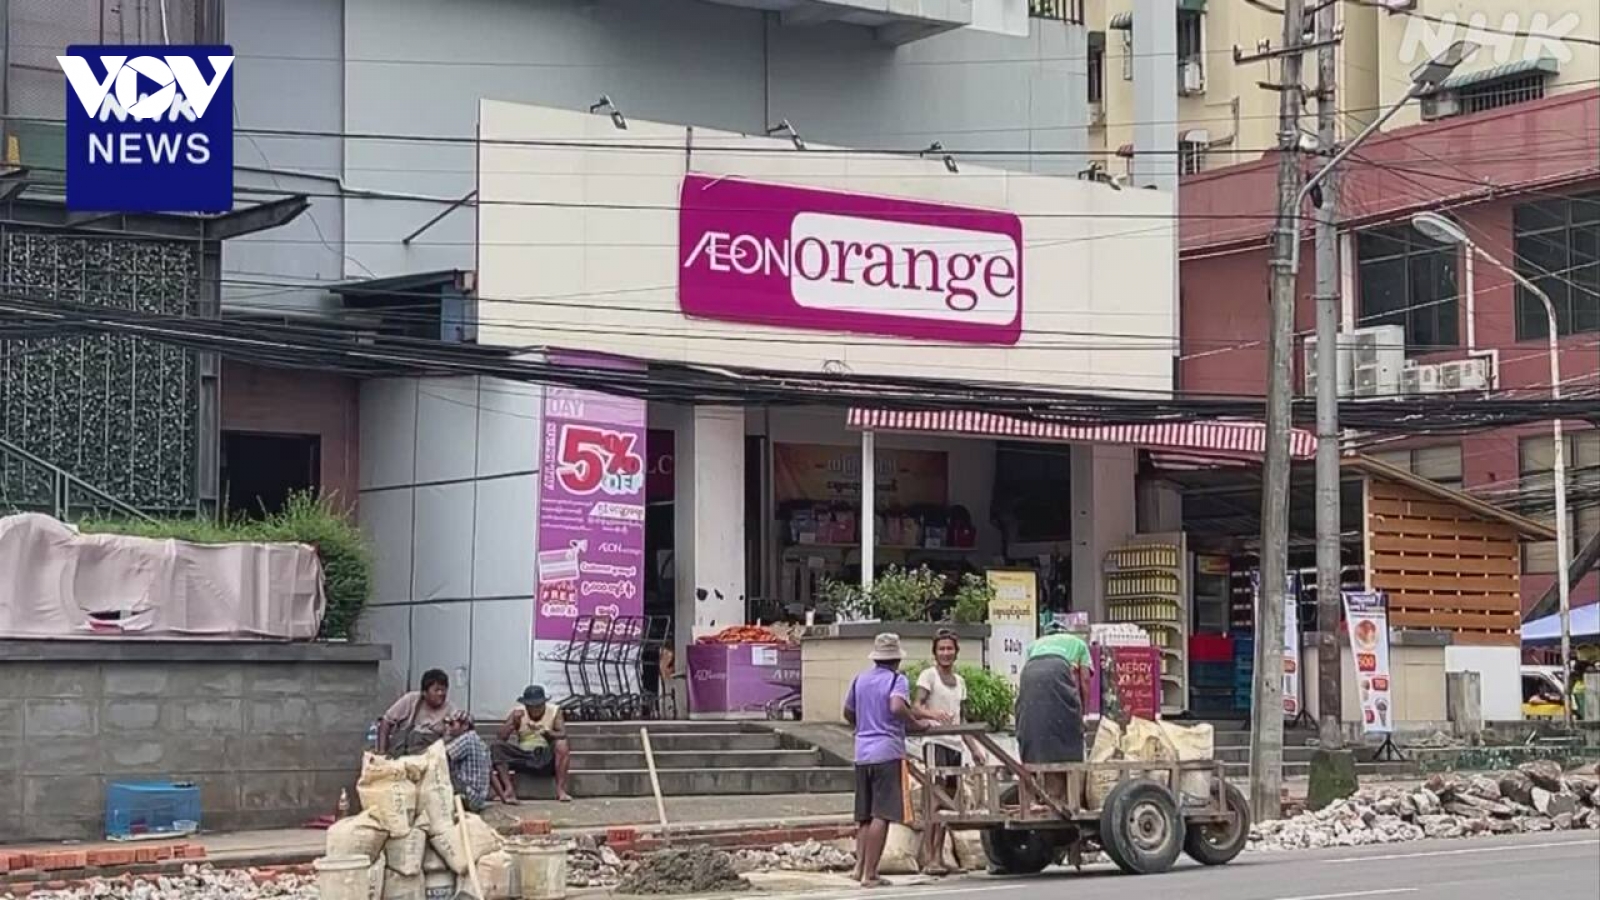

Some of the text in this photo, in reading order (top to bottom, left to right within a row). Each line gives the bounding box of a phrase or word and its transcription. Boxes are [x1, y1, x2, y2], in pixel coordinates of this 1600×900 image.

[793, 235, 1017, 312] orange
[557, 425, 642, 494] 5%
[542, 589, 576, 602] FREE
[1115, 662, 1152, 673] MERRY
[1117, 674, 1152, 686] XMAS
